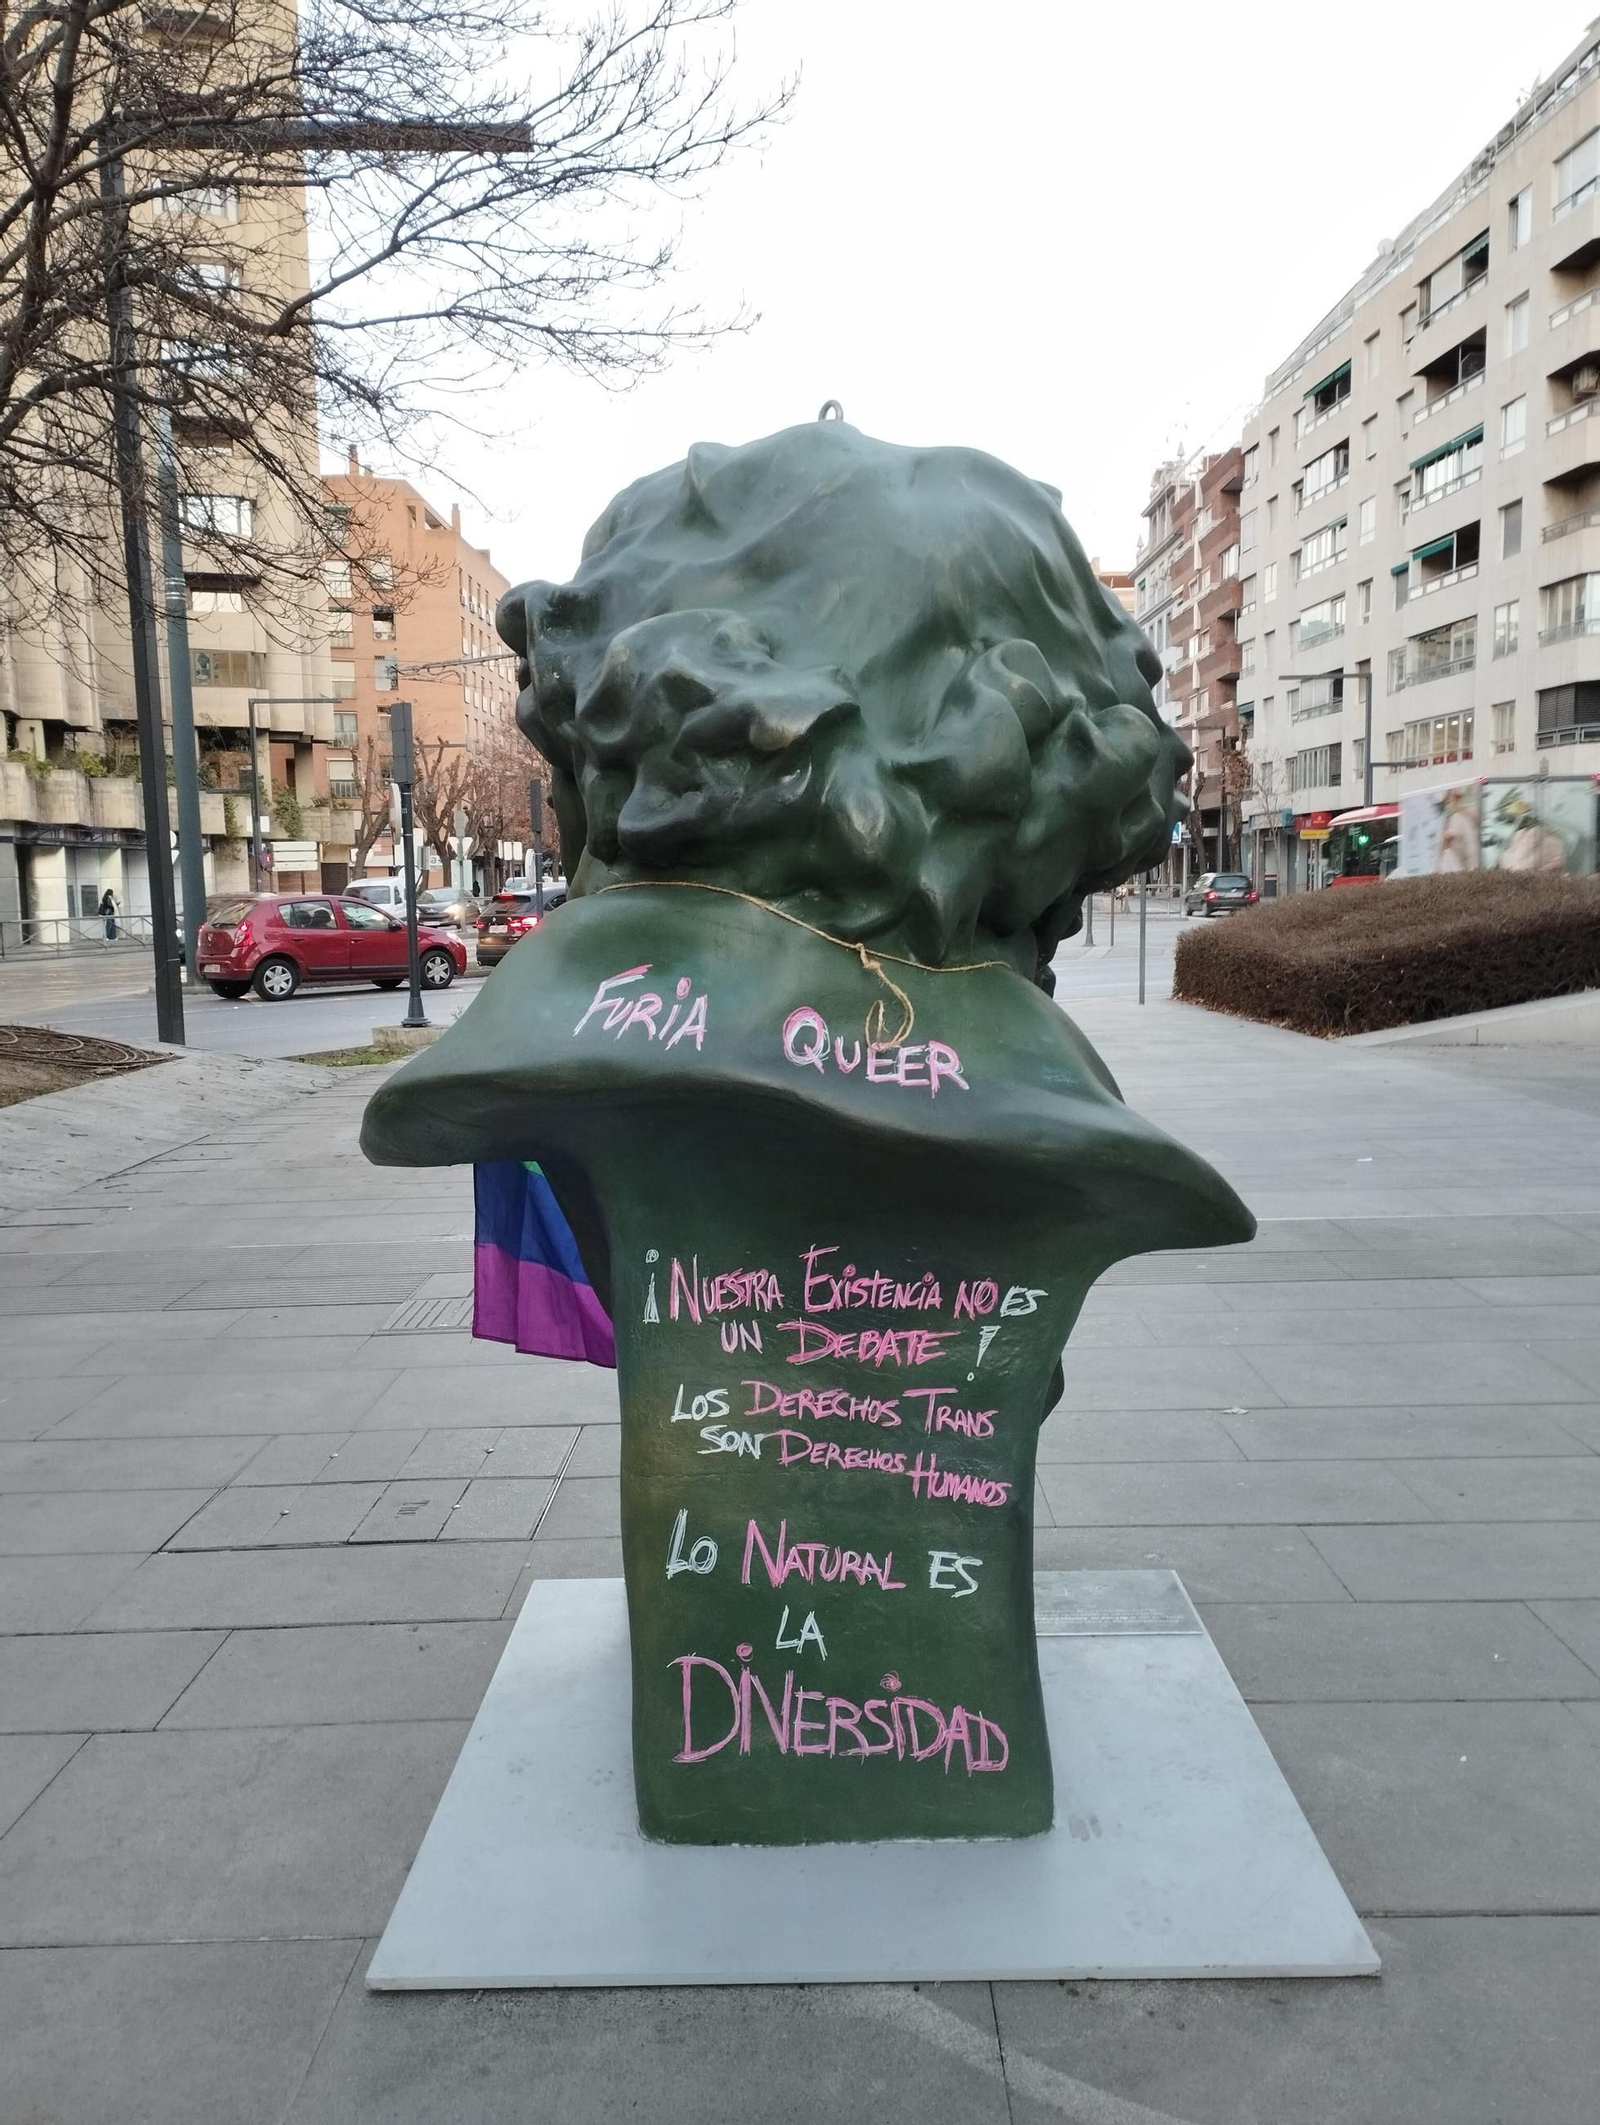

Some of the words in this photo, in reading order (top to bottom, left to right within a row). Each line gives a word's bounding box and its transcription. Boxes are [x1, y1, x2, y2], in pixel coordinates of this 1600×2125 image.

[782, 1006, 969, 1098] QUEER
[954, 1277, 999, 1320] NO
[1000, 1286, 1049, 1317] ES
[721, 1320, 763, 1353] UN
[777, 1318, 961, 1366] DEBATE
[671, 1383, 730, 1422] LOS
[741, 1380, 902, 1427] DERECHOS
[902, 1388, 998, 1438] TRANS
[697, 1424, 765, 1459] SON
[764, 1429, 905, 1473] DERECHOS
[906, 1451, 1012, 1507] HUMANOS
[666, 1509, 718, 1579] LO
[741, 1518, 907, 1590] NATURAL
[928, 1551, 983, 1598] ES
[776, 1605, 828, 1661] LA
